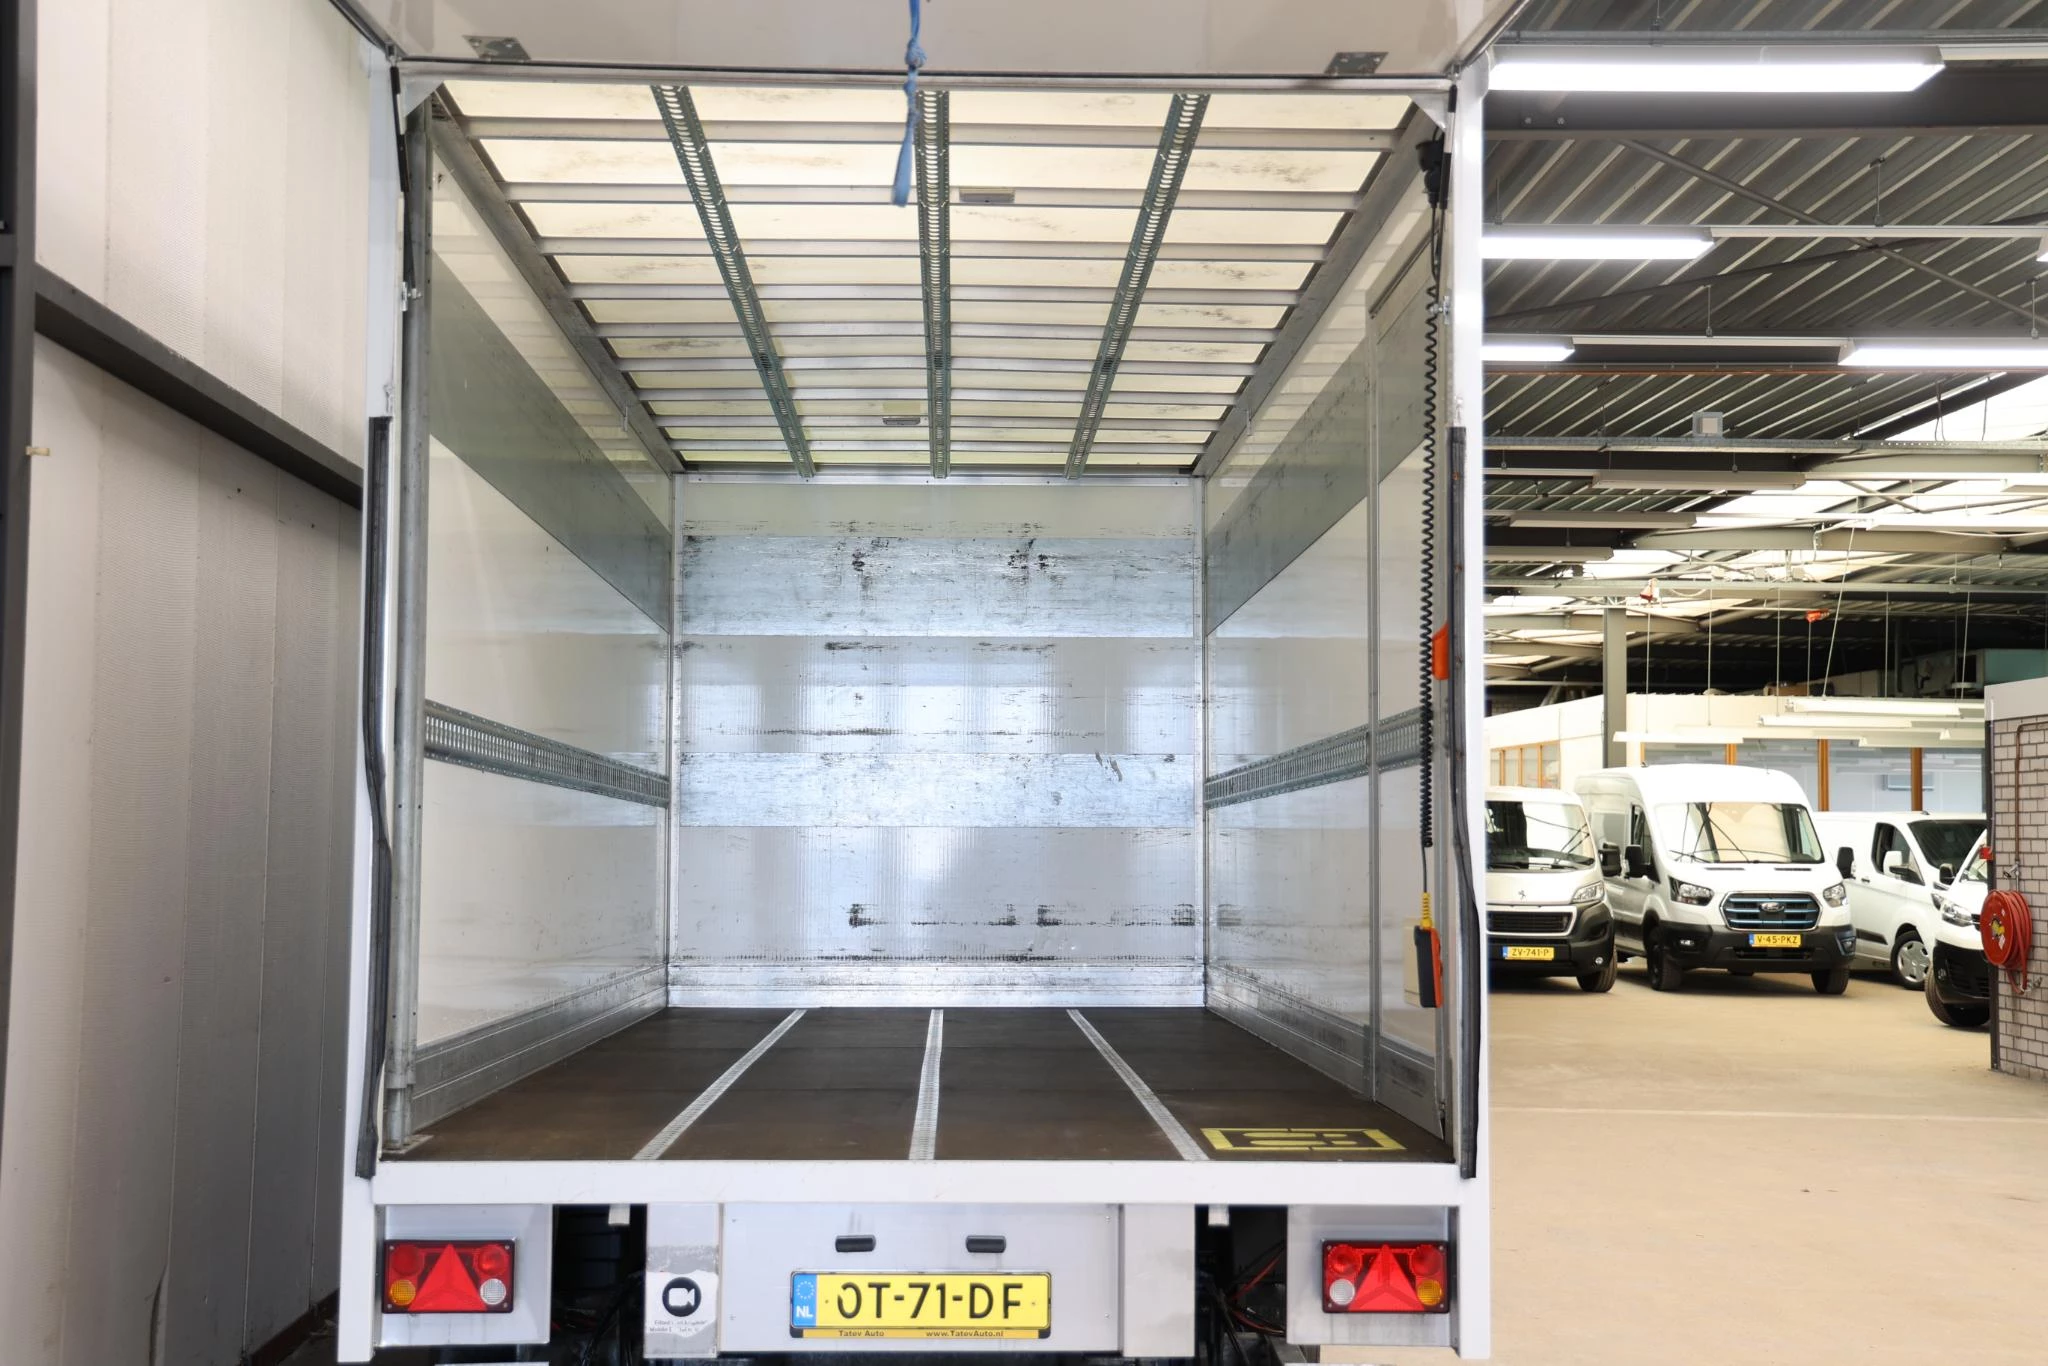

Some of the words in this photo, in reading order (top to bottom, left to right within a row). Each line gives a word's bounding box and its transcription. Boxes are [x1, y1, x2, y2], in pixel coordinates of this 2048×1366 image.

[1757, 935, 1798, 944] V-45-PKZ
[837, 1282, 1023, 1319] OT-71-DF
[796, 1305, 813, 1318] NL
